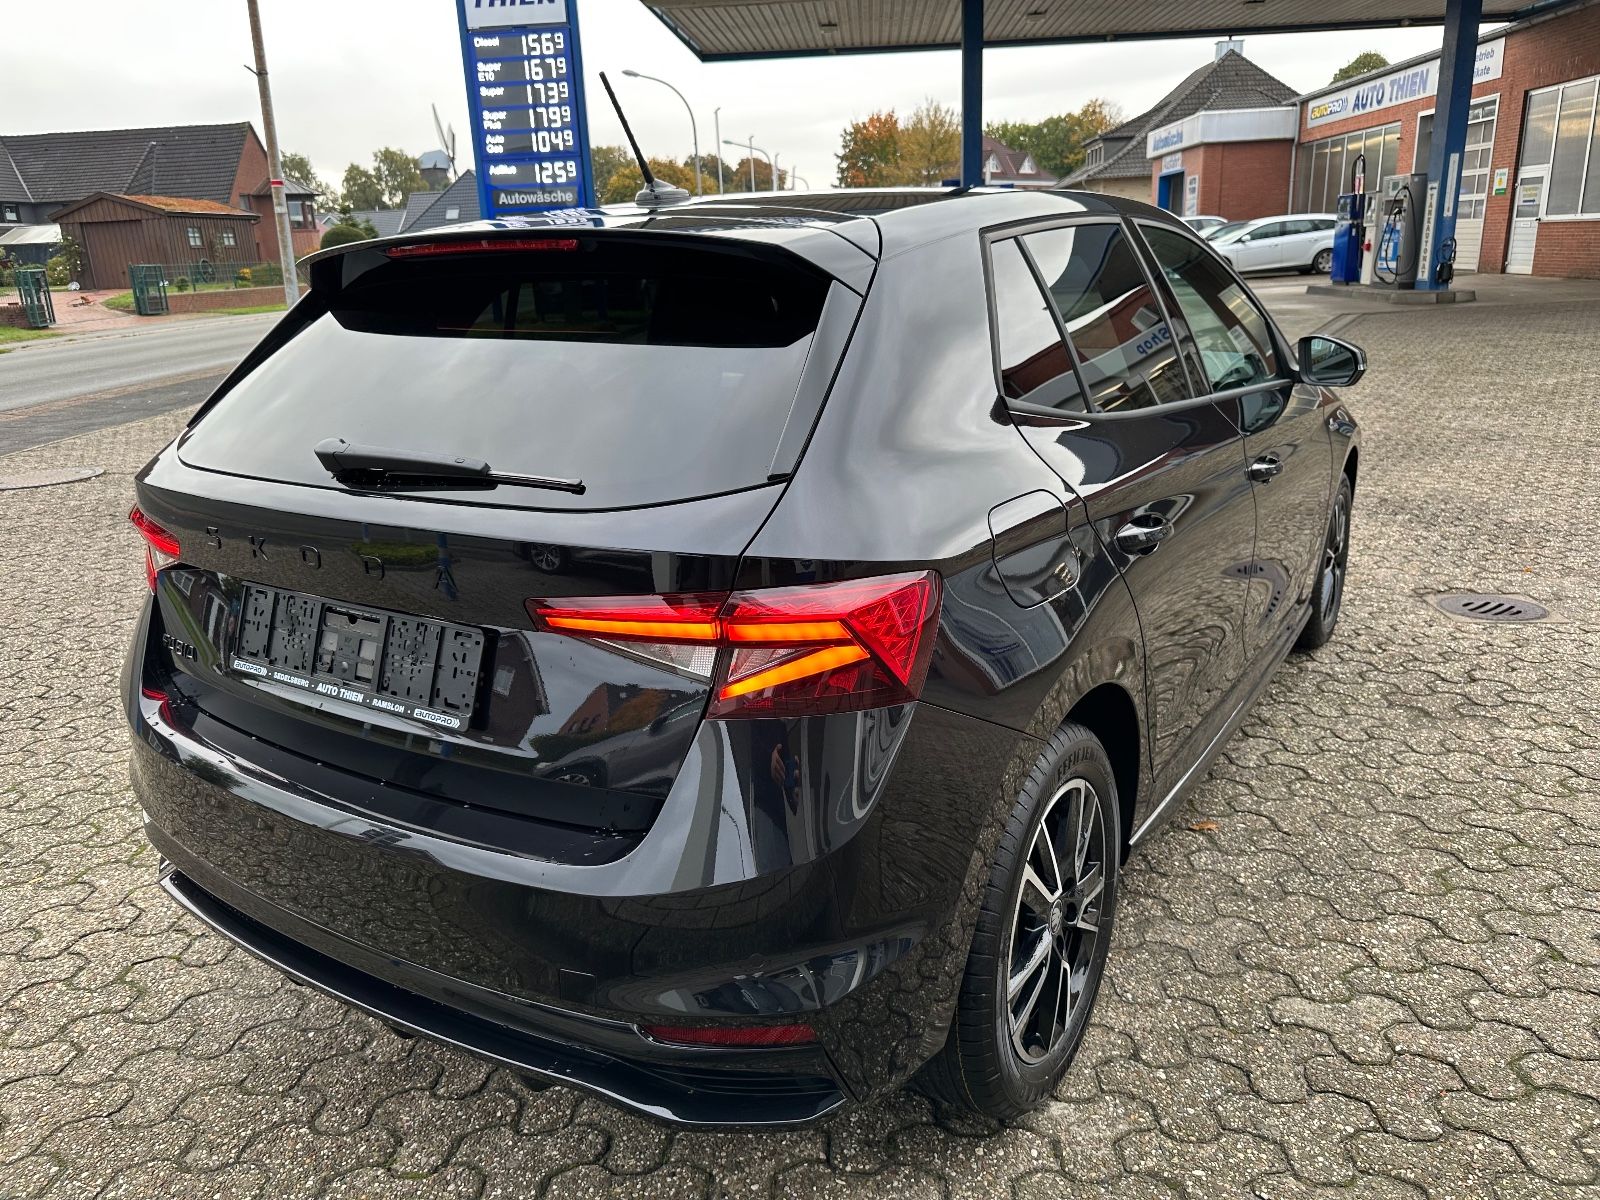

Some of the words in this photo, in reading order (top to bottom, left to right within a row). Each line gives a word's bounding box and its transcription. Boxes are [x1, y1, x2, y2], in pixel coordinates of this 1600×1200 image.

[477, 61, 501, 72] Super
[478, 71, 495, 81] E10
[480, 86, 504, 97] Super
[1352, 82, 1385, 113] AUTO
[1388, 68, 1429, 103] THIEN
[483, 110, 506, 121] Super
[499, 191, 573, 205] Autowäsche
[273, 671, 310, 688] SEDELSBERG
[316, 682, 338, 696] AUTO
[340, 688, 364, 703] THIEN
[372, 698, 405, 714] RAMSLOH
